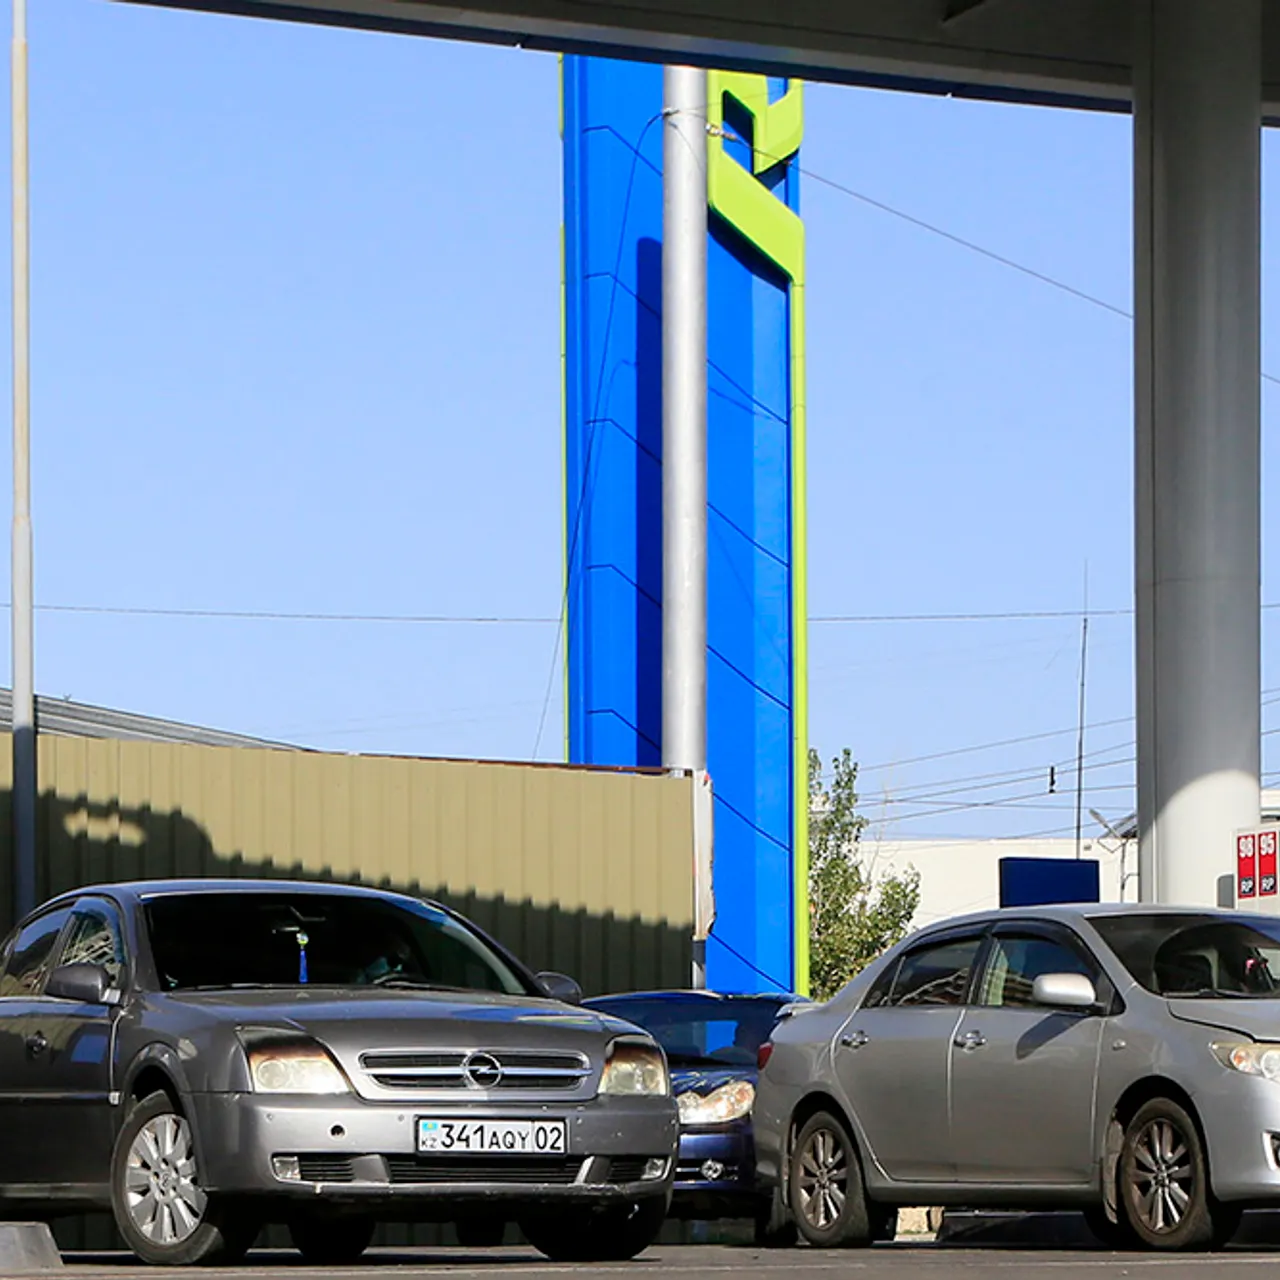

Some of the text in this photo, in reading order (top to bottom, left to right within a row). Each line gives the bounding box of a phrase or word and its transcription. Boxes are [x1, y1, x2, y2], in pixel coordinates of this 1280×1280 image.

[1239, 837, 1254, 858] 98
[1260, 834, 1275, 856] 95
[535, 1126, 563, 1150] 02
